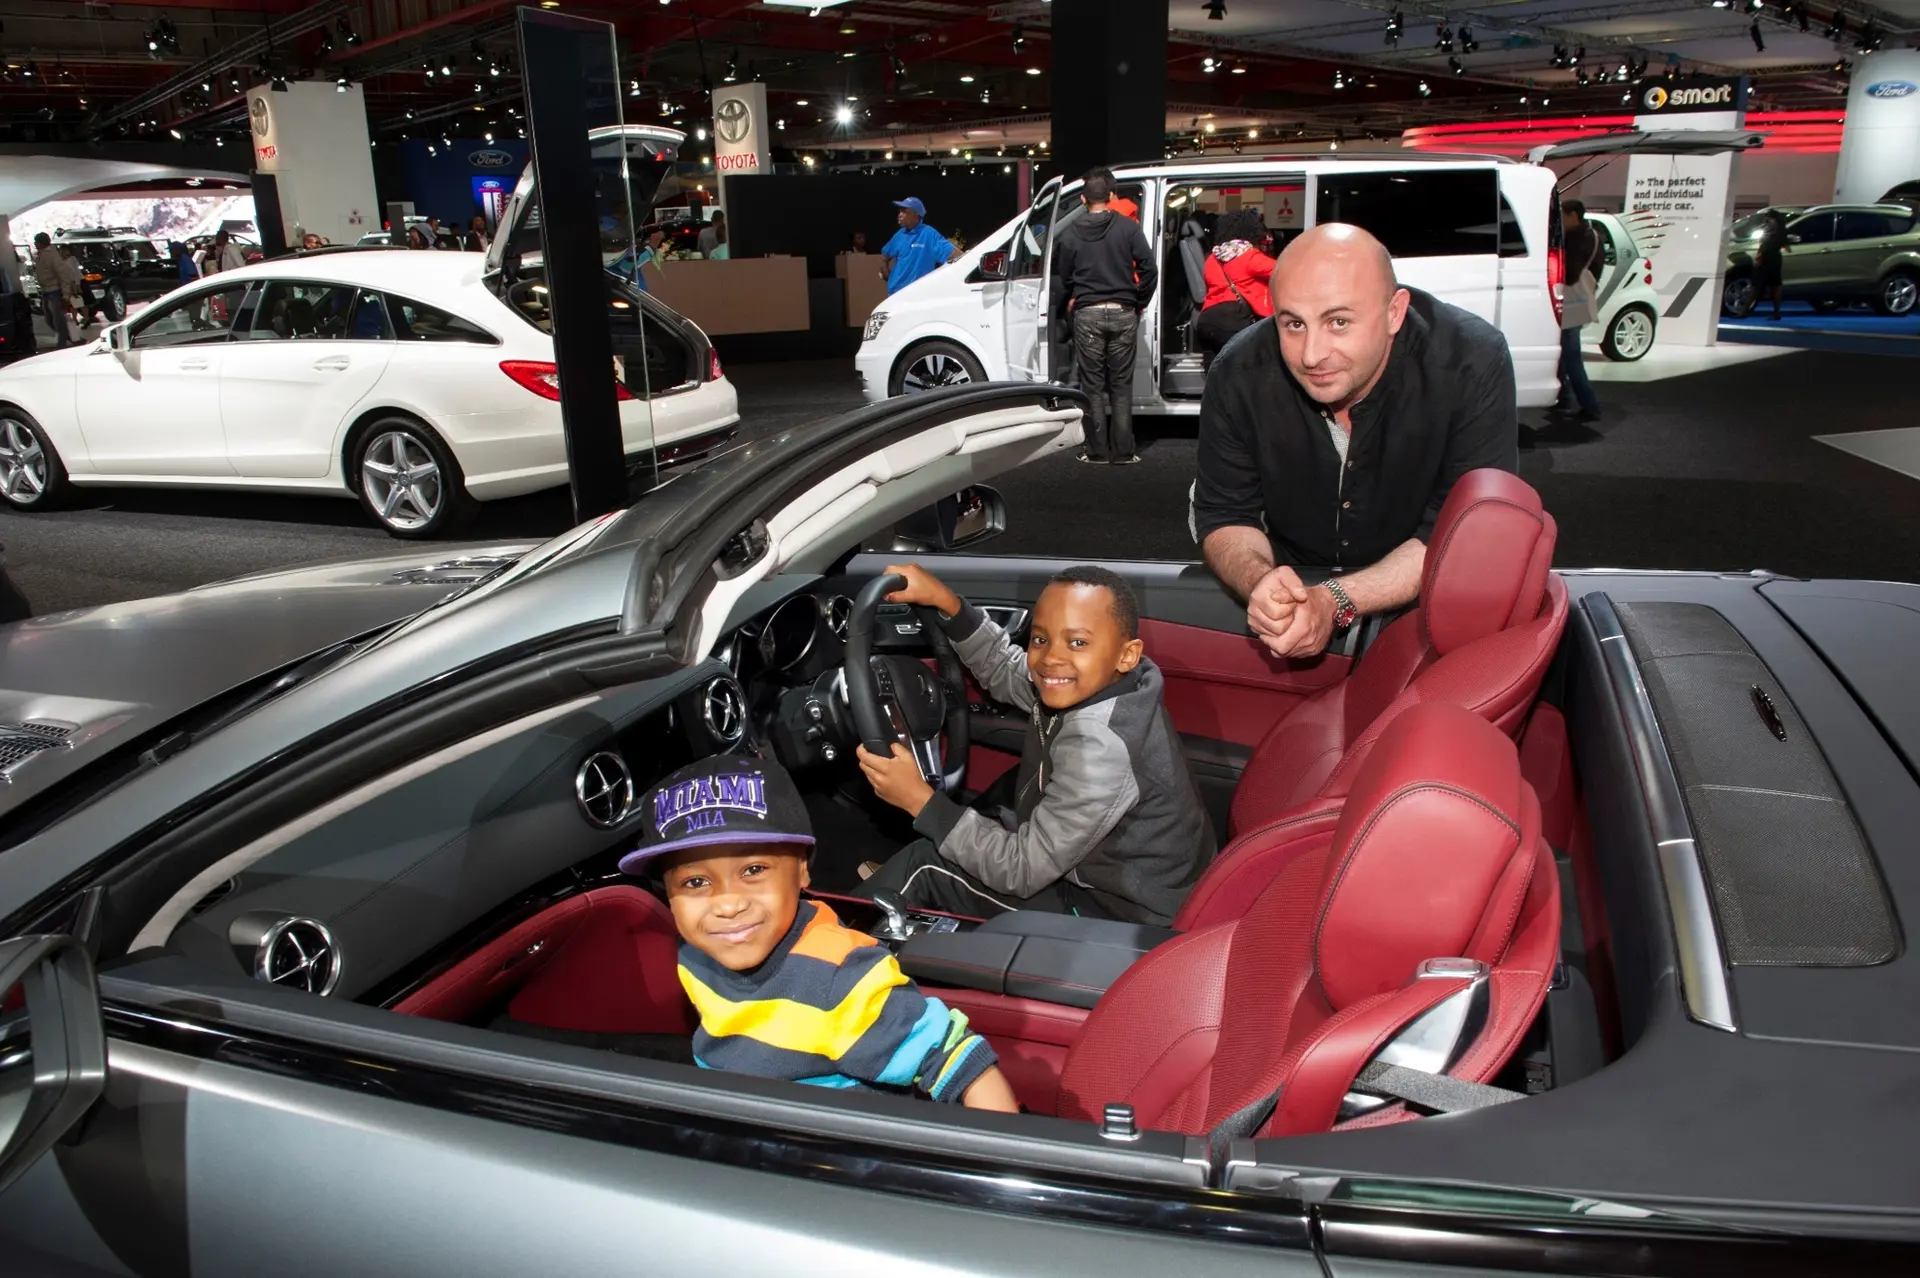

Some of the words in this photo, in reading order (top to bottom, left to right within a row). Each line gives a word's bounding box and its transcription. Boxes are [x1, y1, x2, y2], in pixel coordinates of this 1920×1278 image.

[1669, 84, 1732, 106] smart
[1875, 83, 1909, 97] Ford
[476, 152, 504, 165] Ford
[715, 153, 757, 169] TOYOTA
[1647, 177, 1665, 187] The
[1667, 175, 1706, 189] perfect
[1633, 190, 1651, 199] and
[1653, 188, 1704, 199] individual
[1632, 201, 1672, 211] electric
[1674, 203, 1695, 211] car.
[655, 774, 767, 832] MIAMI
[685, 809, 726, 833] MIA
